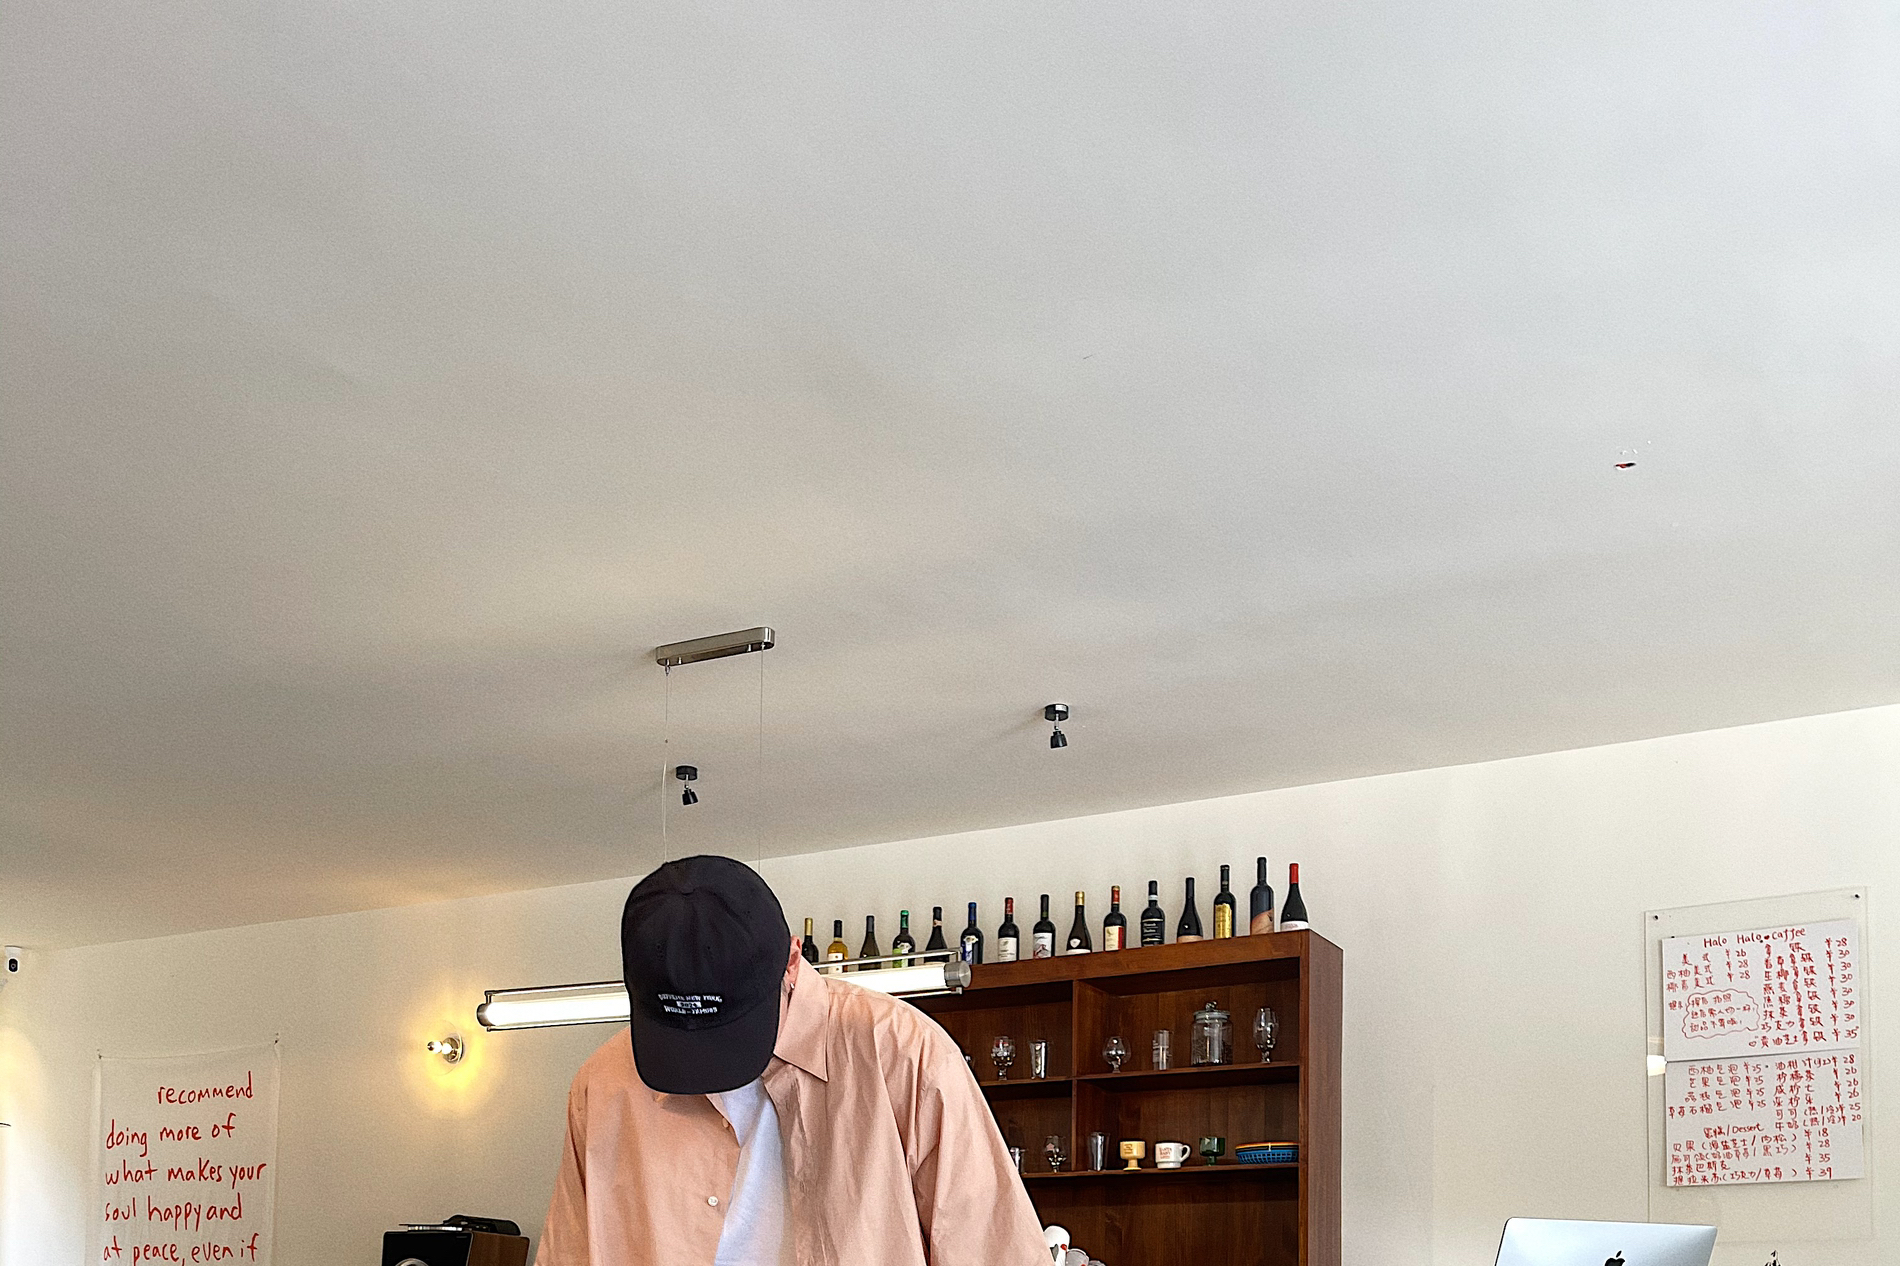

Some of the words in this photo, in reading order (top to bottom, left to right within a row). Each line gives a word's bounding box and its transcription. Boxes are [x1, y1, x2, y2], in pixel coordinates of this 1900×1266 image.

[1704, 936, 1727, 948] Halo
[1737, 932, 1761, 944] Halo
[157, 1070, 253, 1104] recommend
[106, 1119, 147, 1157] doing
[160, 1125, 201, 1141] more
[212, 1112, 236, 1138] of
[105, 1159, 158, 1185] what
[167, 1157, 222, 1182] makes
[229, 1163, 267, 1189] your
[105, 1197, 136, 1221] soul
[148, 1196, 201, 1232] happy
[207, 1192, 242, 1221] and
[104, 1236, 122, 1261] at
[191, 1242, 234, 1263] even
[240, 1232, 259, 1262] if
